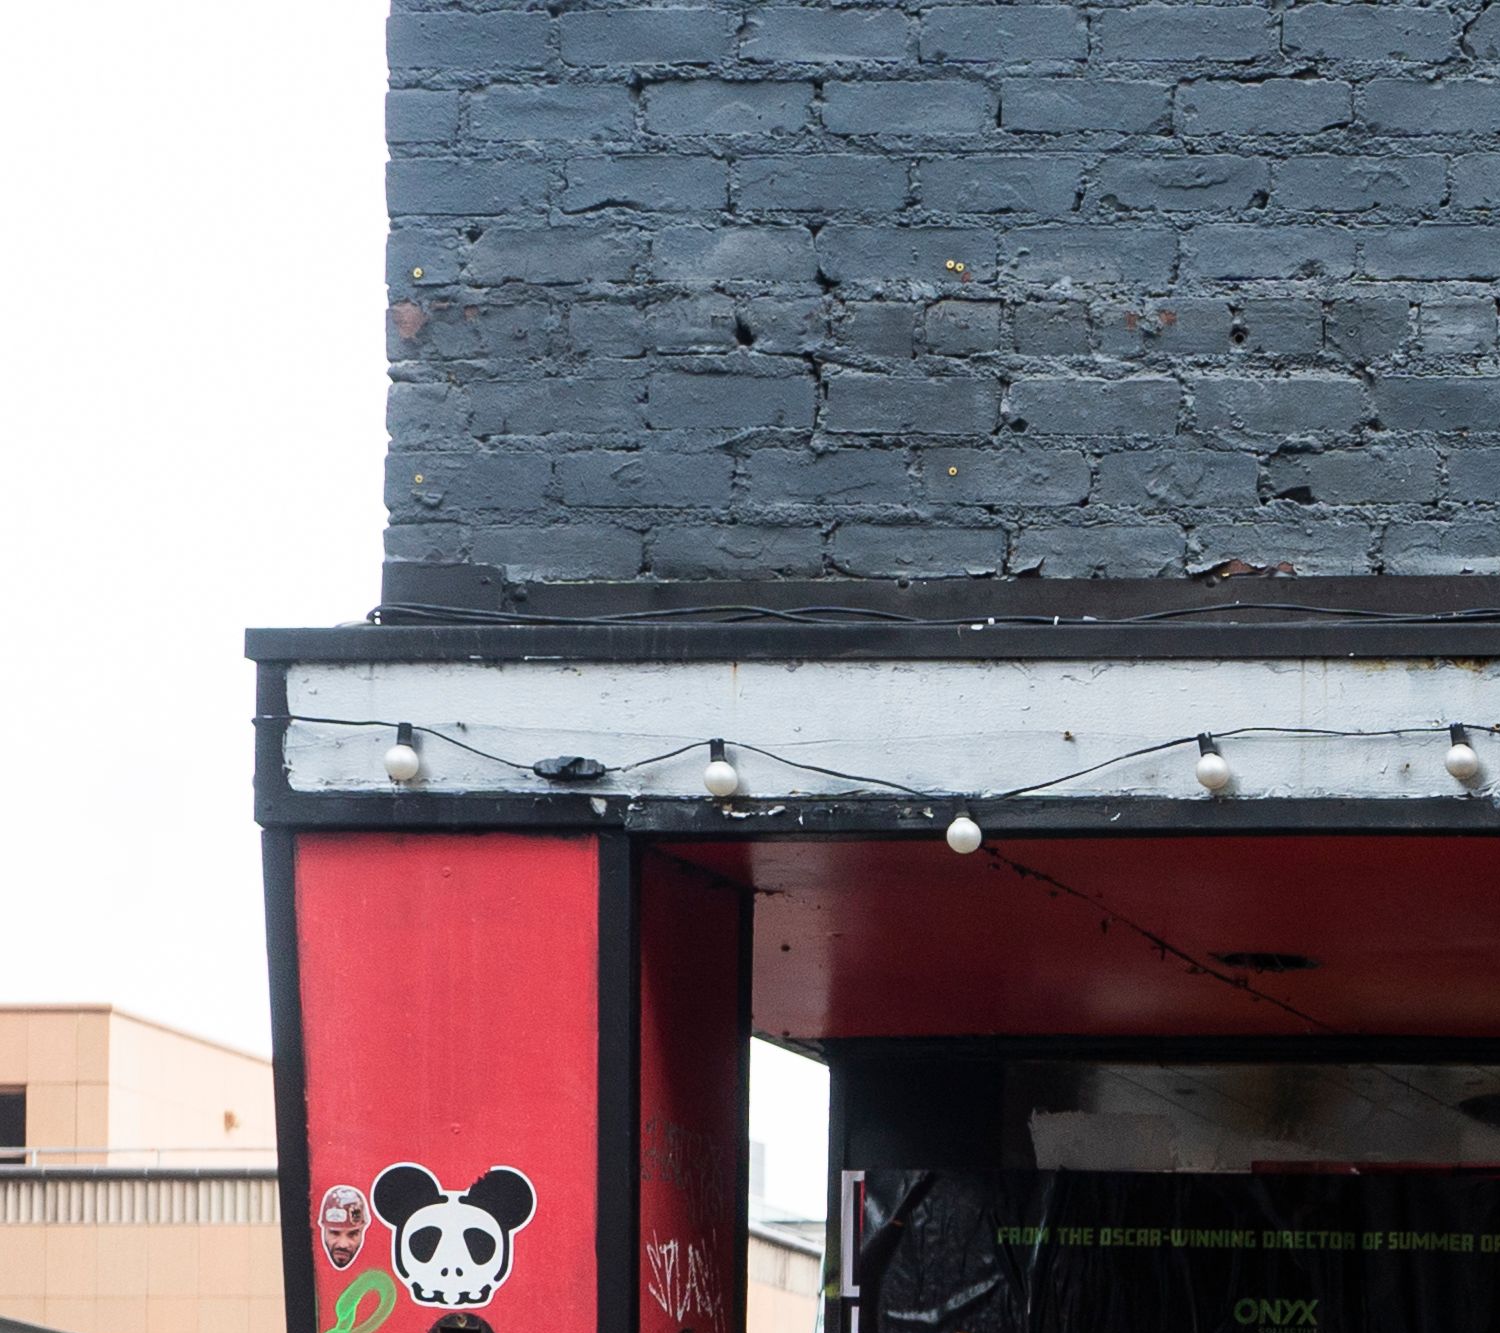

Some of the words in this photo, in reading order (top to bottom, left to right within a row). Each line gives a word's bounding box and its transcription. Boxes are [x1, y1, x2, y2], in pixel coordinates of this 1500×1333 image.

[997, 1227, 1049, 1245] FROM
[1057, 1227, 1094, 1246] THE
[1100, 1228, 1256, 1248] OSCAR-WINNING
[1262, 1230, 1355, 1250] DIRECTOR
[1362, 1231, 1383, 1250] OF
[1388, 1232, 1473, 1251] SUMMER
[1234, 1298, 1319, 1325] ONYX
